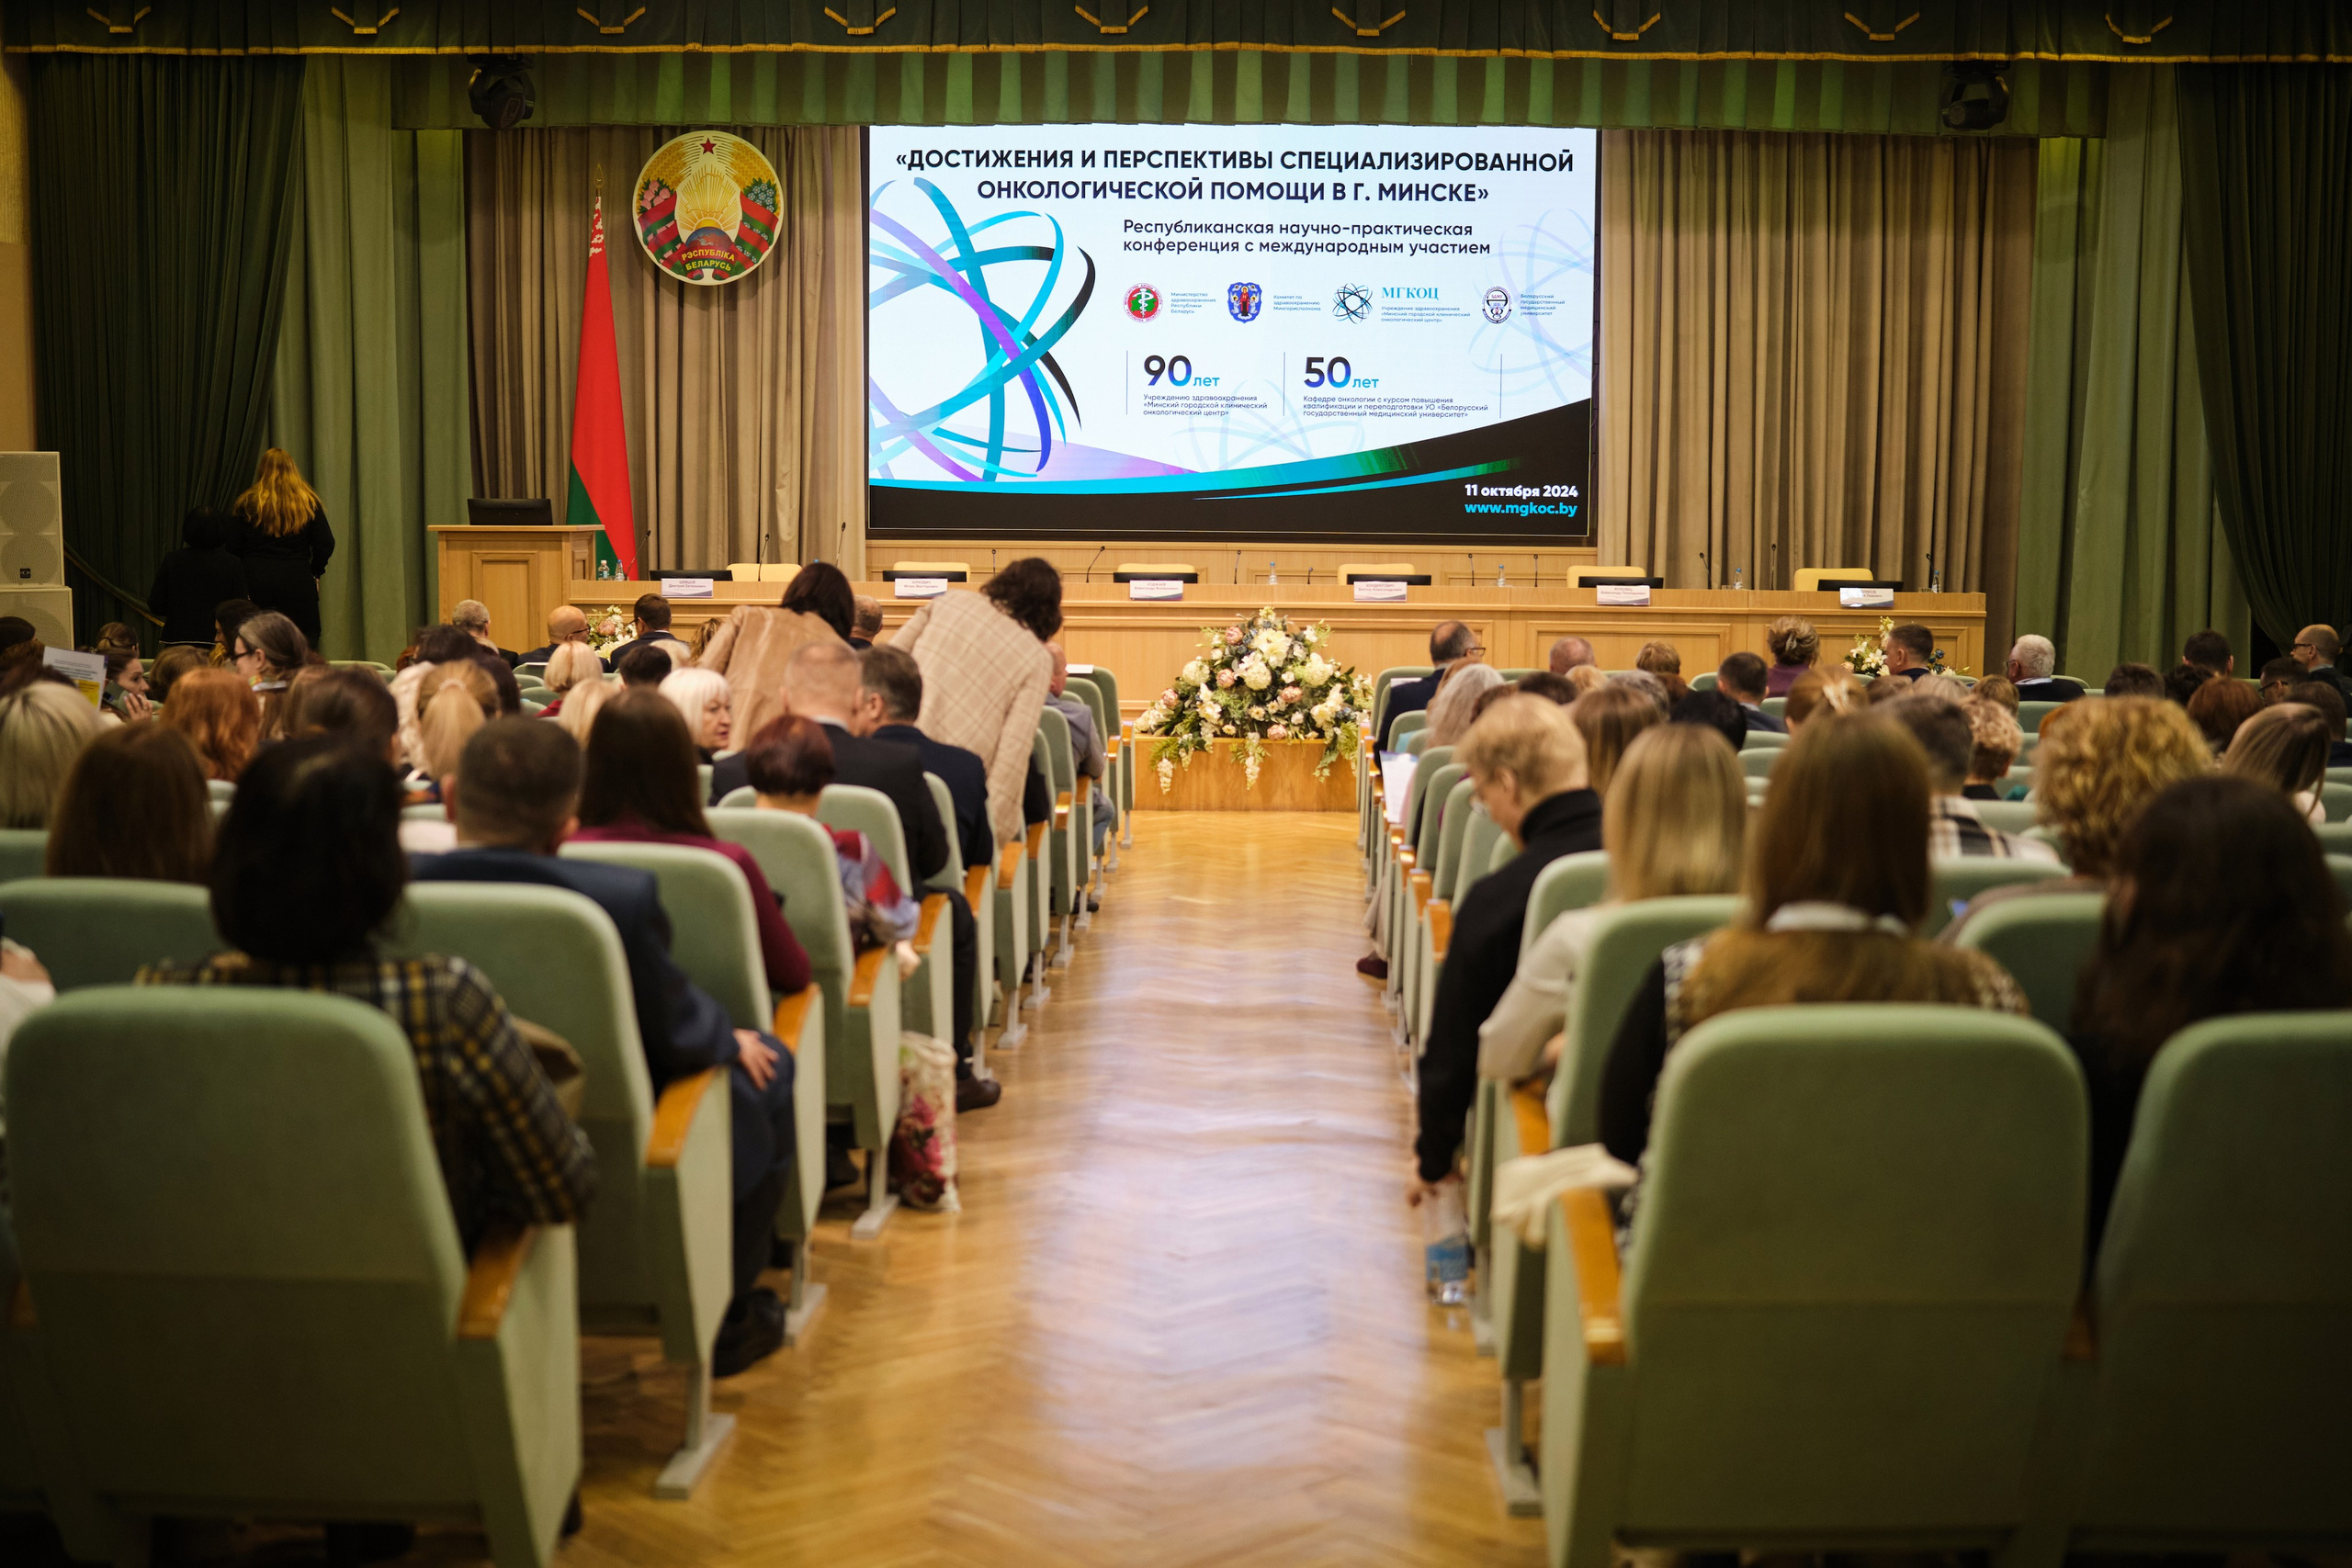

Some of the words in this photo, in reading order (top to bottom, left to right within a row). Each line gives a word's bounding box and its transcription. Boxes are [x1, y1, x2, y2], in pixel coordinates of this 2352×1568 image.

[896, 150, 1073, 171] «ДОСТИЖЕНИЯ
[1081, 150, 1096, 168] И
[1104, 150, 1273, 170] ПЕРСПЕКТИВЫ
[1280, 149, 1574, 173] СПЕЦИАЛИЗИРОВАННОЙ
[977, 177, 1203, 199] ОНКОЛОГИЧЕСКОЙ
[1211, 181, 1325, 204] ПОМОЩИ
[1332, 182, 1346, 201] В
[1353, 183, 1371, 201] Г.
[1378, 182, 1489, 202] МИНСКЕ»
[1123, 220, 1274, 235] Республиканская
[1279, 223, 1473, 239] научно-практическая
[1123, 237, 1239, 255] конференция
[1244, 241, 1254, 252] с
[1259, 240, 1404, 255] международным
[1409, 243, 1491, 256] участием
[681, 249, 735, 262] РЭСПУБЛІКА
[685, 260, 731, 271] БЕЛАРУСЬ
[1381, 287, 1440, 300] МГКОЦ
[1143, 355, 1193, 387] 90
[1193, 377, 1220, 387] лет
[1304, 355, 1351, 389] 50
[1351, 378, 1379, 389] лет
[1143, 394, 1191, 402] Учреждению
[1464, 484, 1478, 496] 11
[1480, 485, 1541, 500] октября
[1543, 485, 1579, 498] 2024
[1464, 502, 1577, 517] www.mgkoc.by
